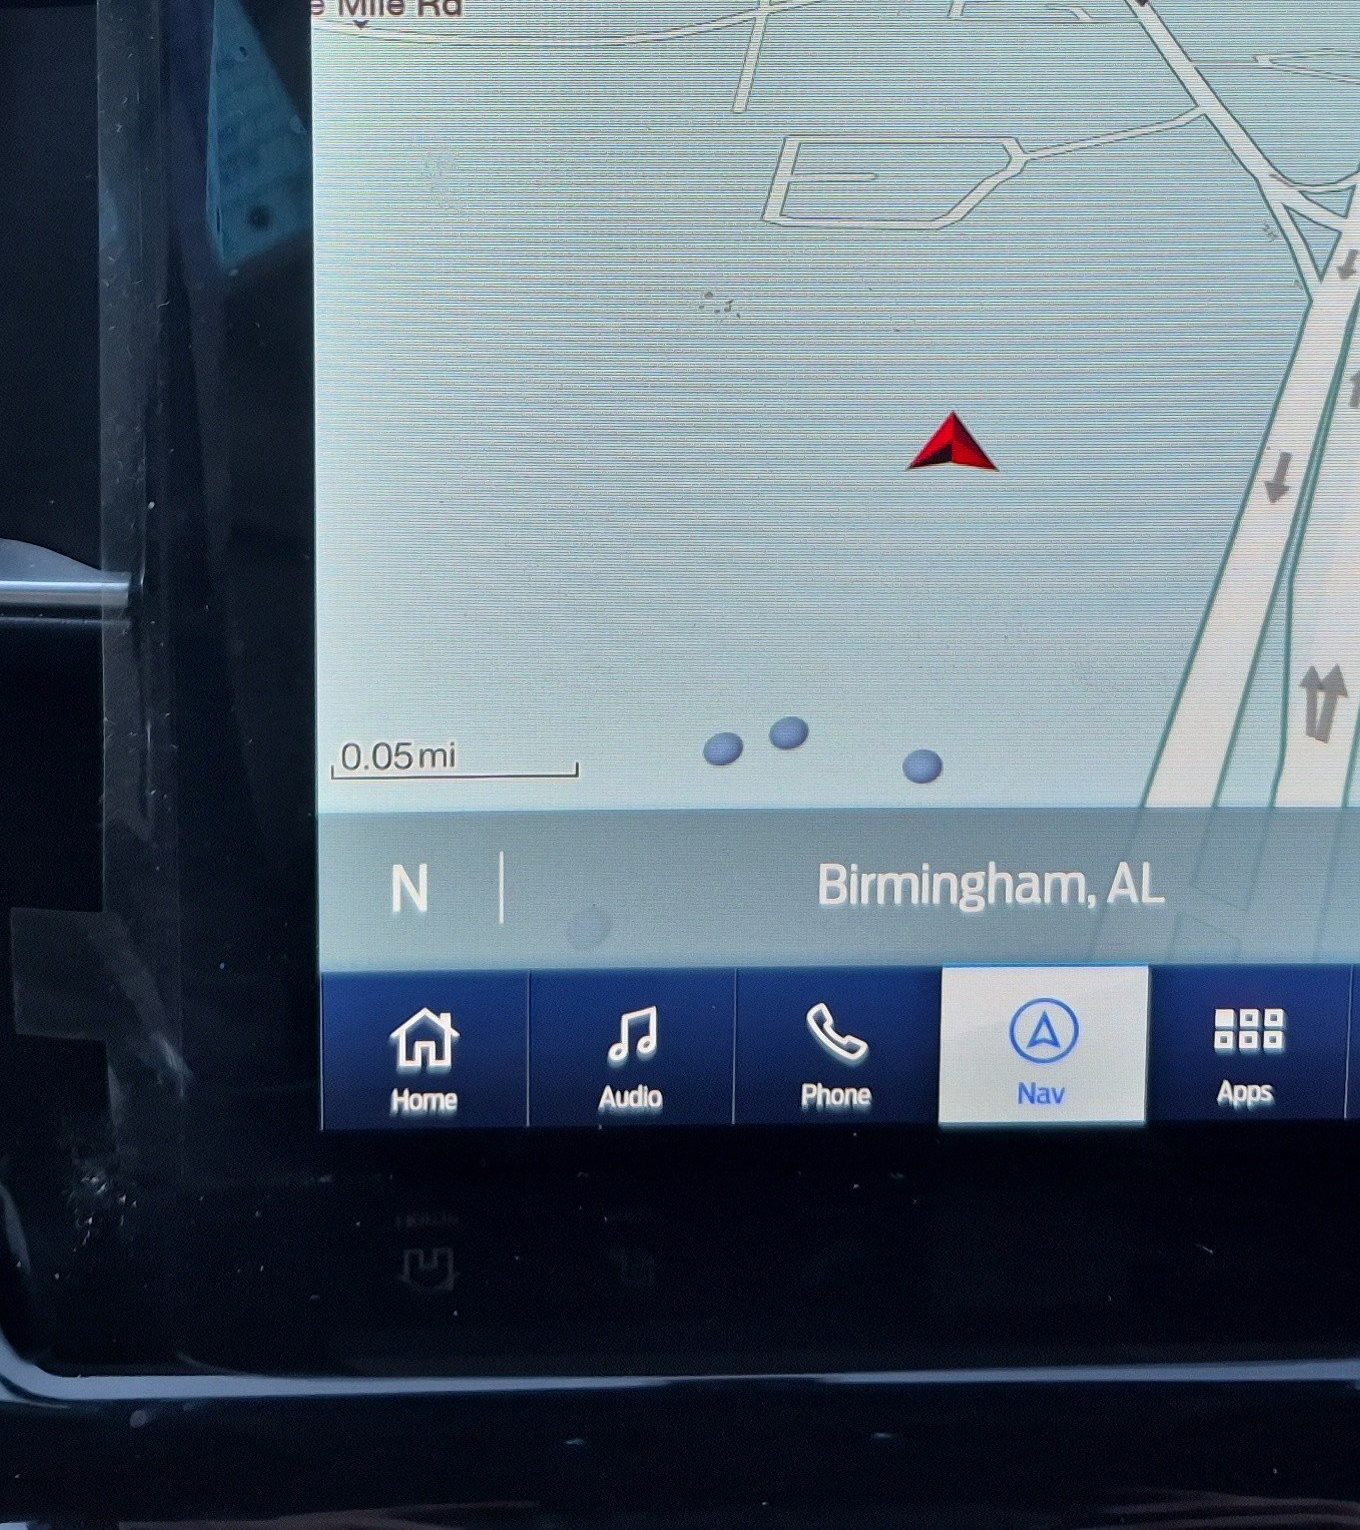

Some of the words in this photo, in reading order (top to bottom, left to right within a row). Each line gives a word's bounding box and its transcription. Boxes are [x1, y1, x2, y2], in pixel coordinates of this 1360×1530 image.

[390, 862, 429, 913] N
[818, 859, 1097, 913] Birmingham,
[1105, 860, 1167, 905] AL
[390, 1087, 459, 1115] Home
[597, 1084, 664, 1111] Audio
[800, 1082, 873, 1109] Phone
[1016, 1081, 1067, 1106] Nav
[1216, 1079, 1275, 1107] Apps
